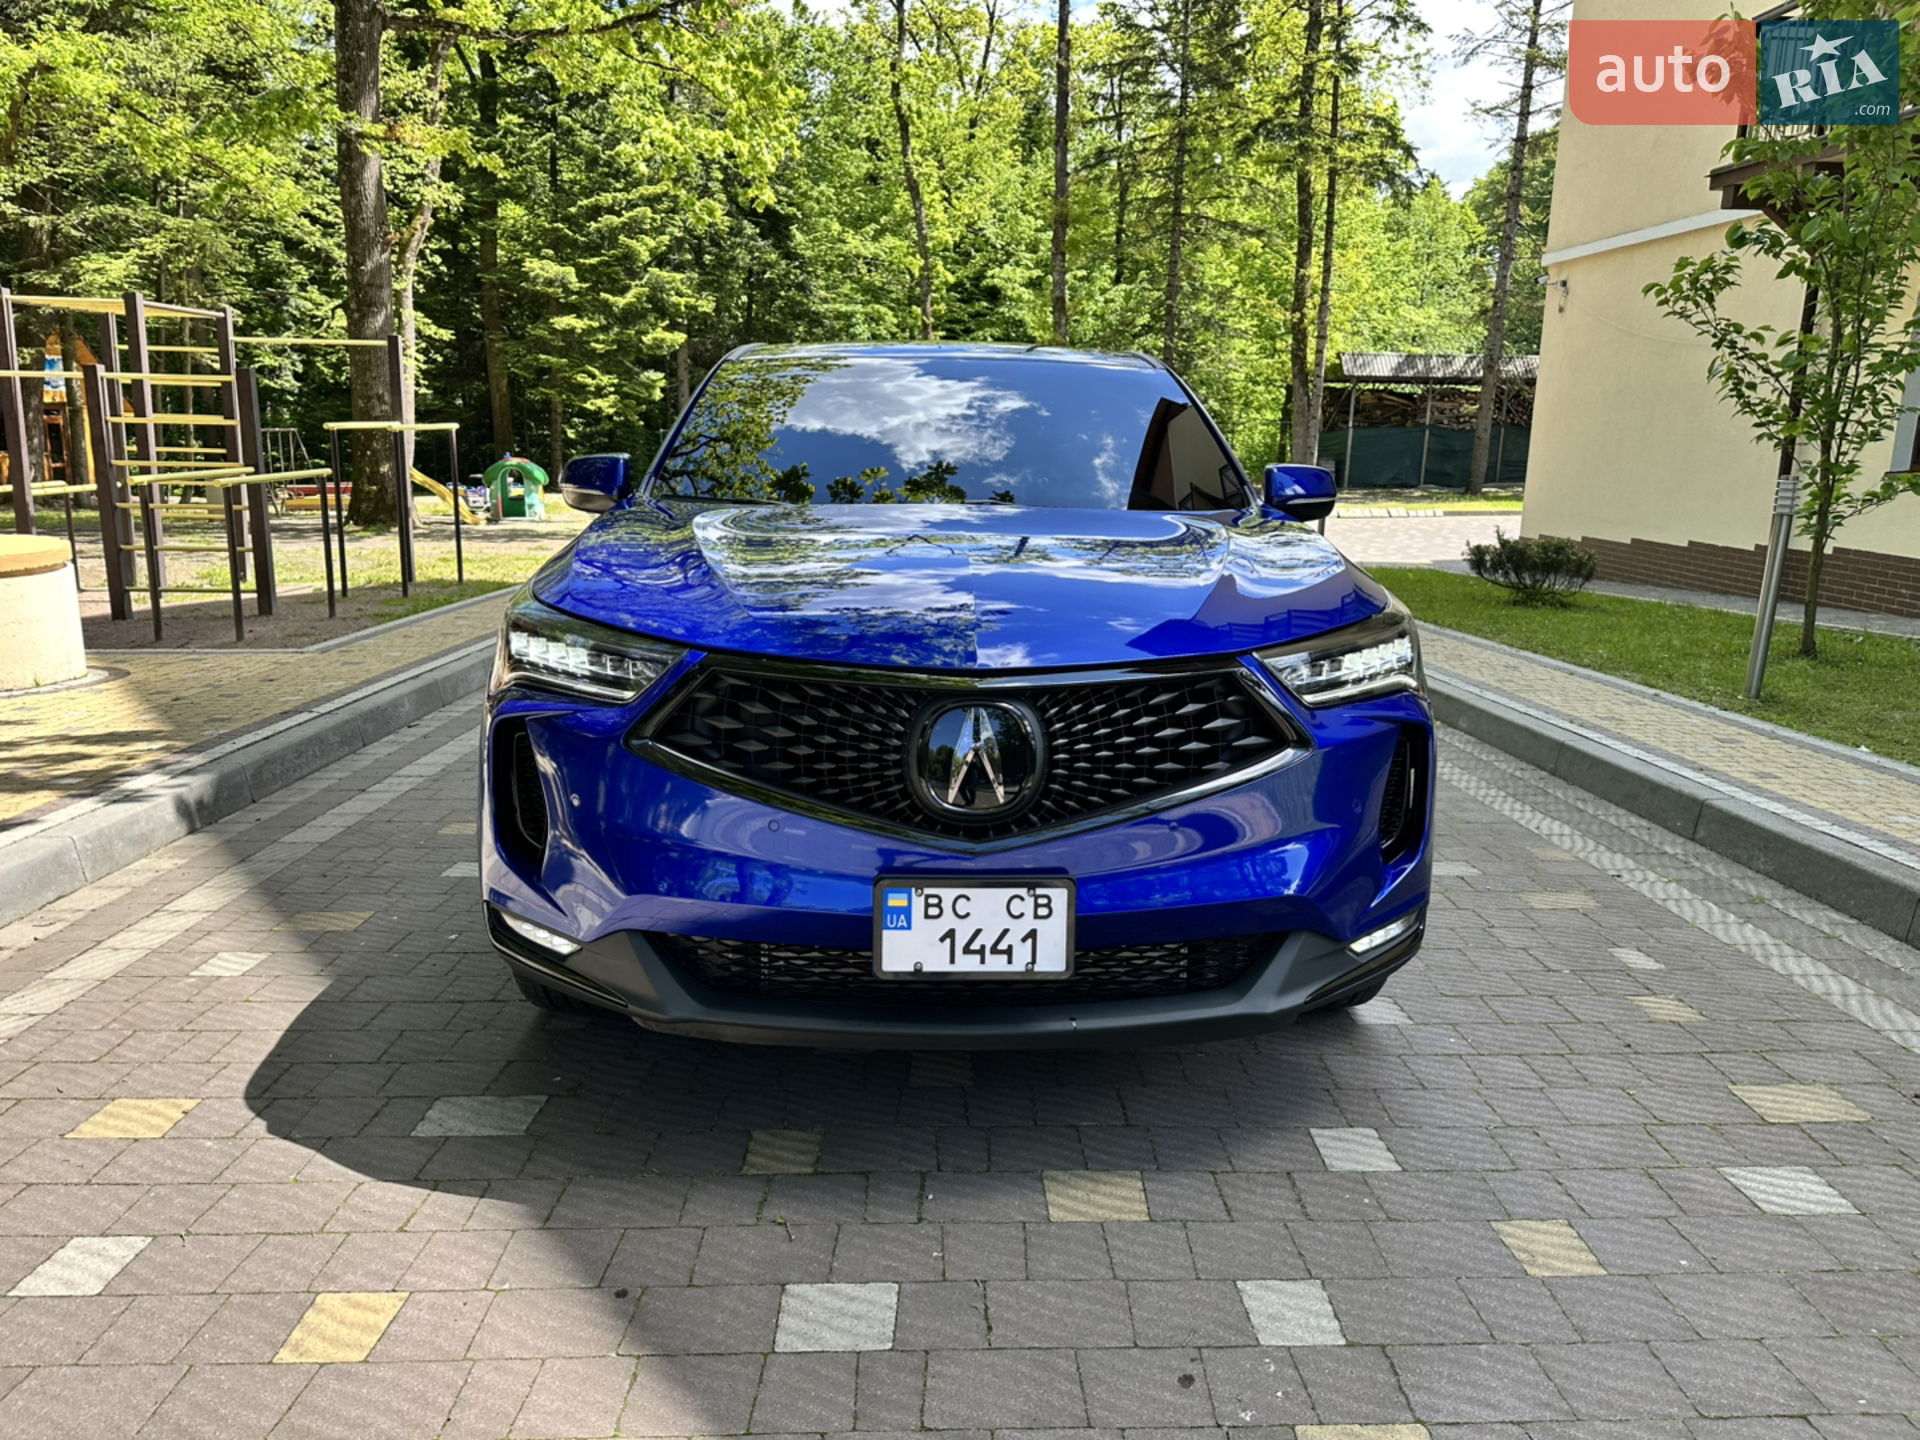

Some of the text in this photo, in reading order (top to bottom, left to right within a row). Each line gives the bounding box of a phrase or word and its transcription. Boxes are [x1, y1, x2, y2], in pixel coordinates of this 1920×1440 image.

[924, 893, 1053, 920] BC CB
[887, 914, 908, 928] UA
[938, 928, 1038, 965] 1441
